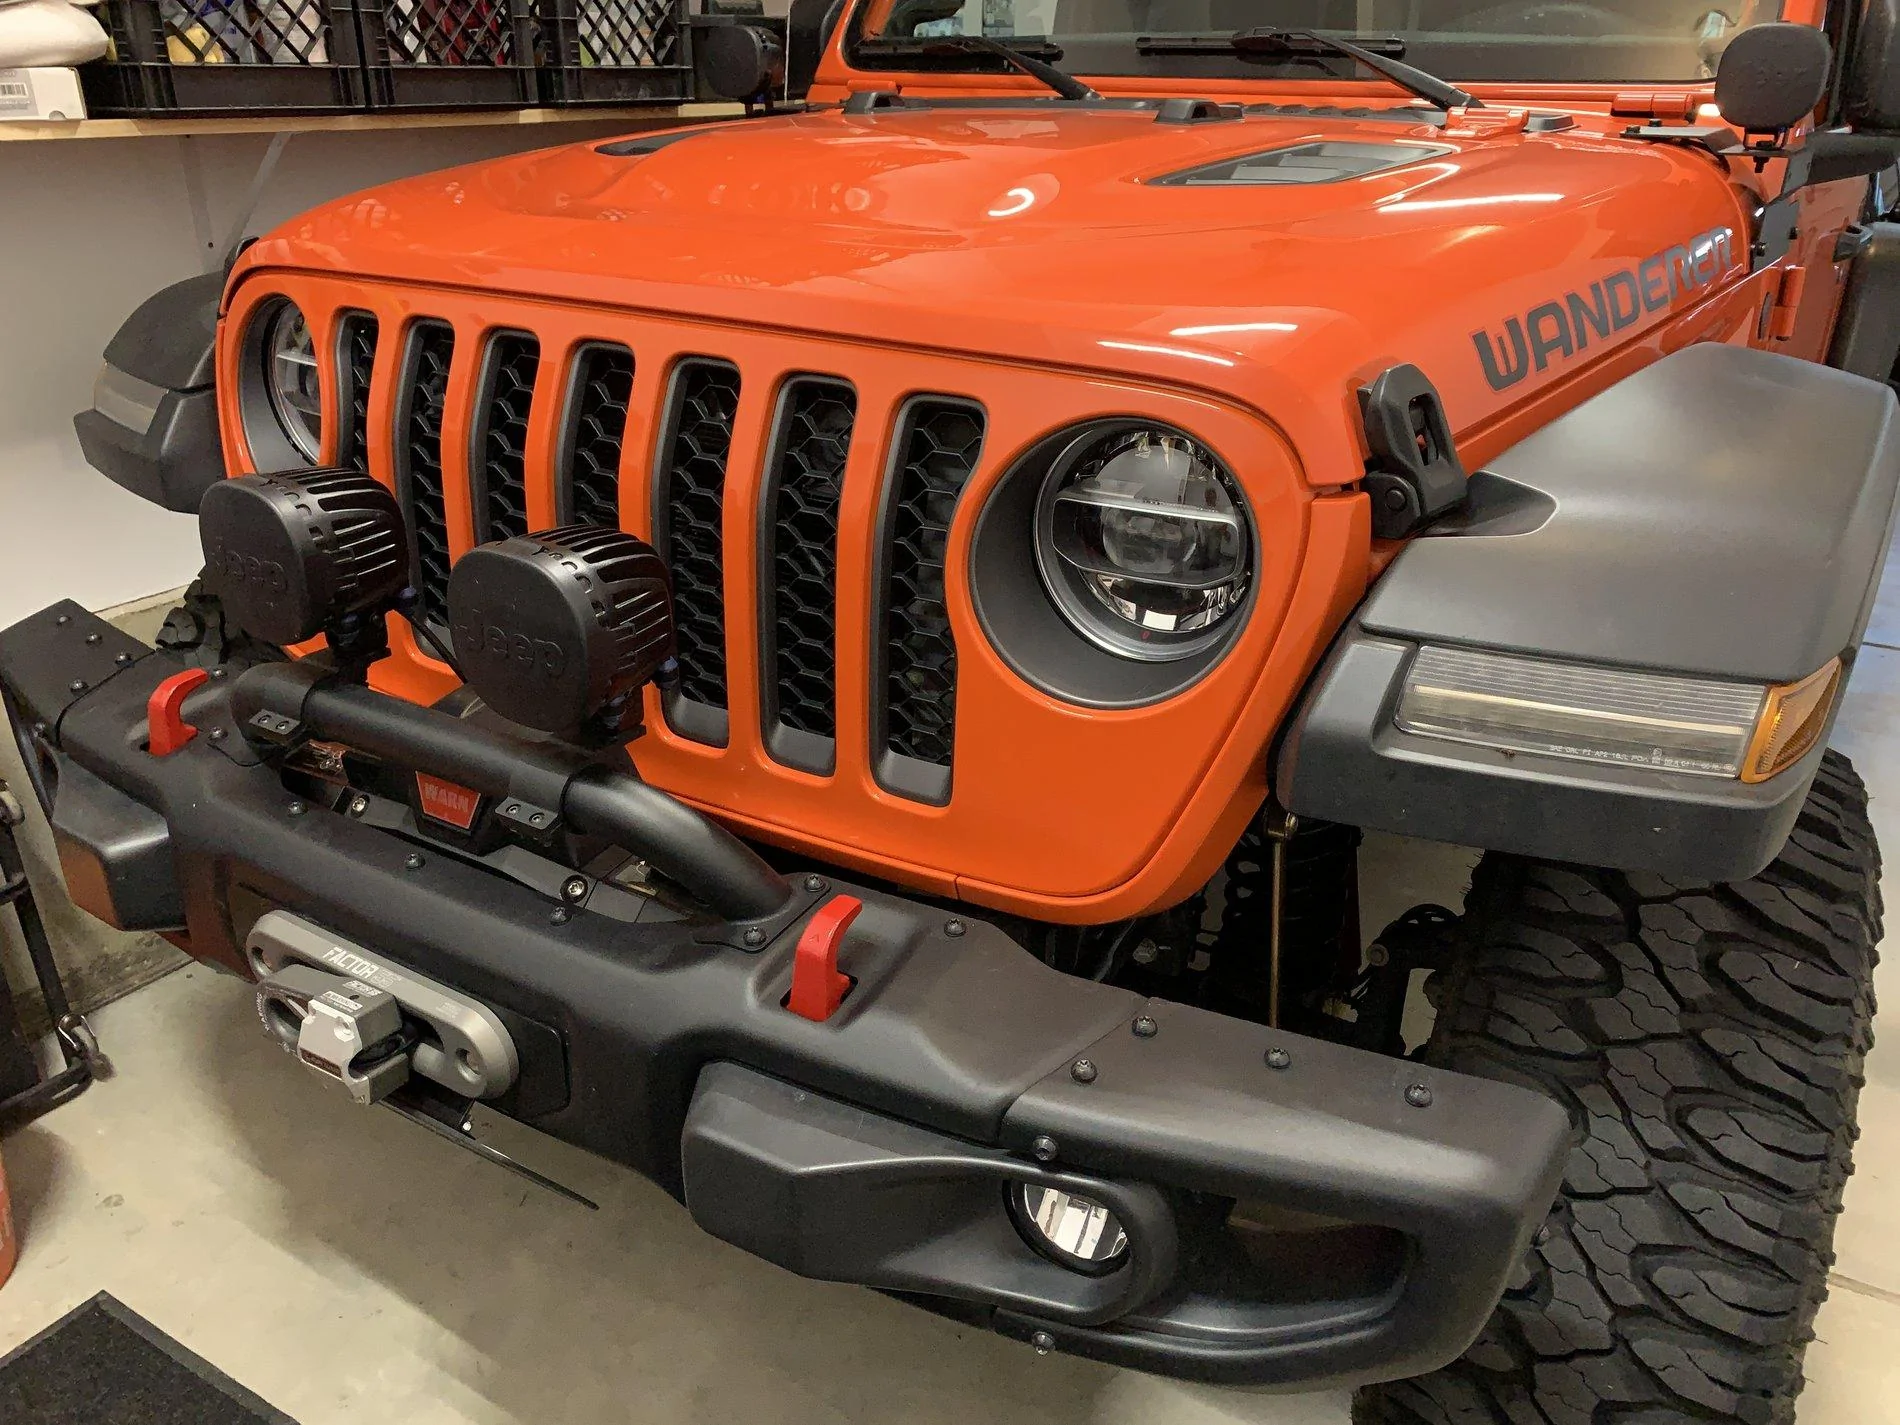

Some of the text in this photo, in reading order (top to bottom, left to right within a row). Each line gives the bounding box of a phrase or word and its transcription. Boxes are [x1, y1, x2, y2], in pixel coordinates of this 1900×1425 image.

[453, 607, 565, 678] Jeep
[424, 781, 469, 813] WARN
[322, 946, 380, 979] FACTOR
